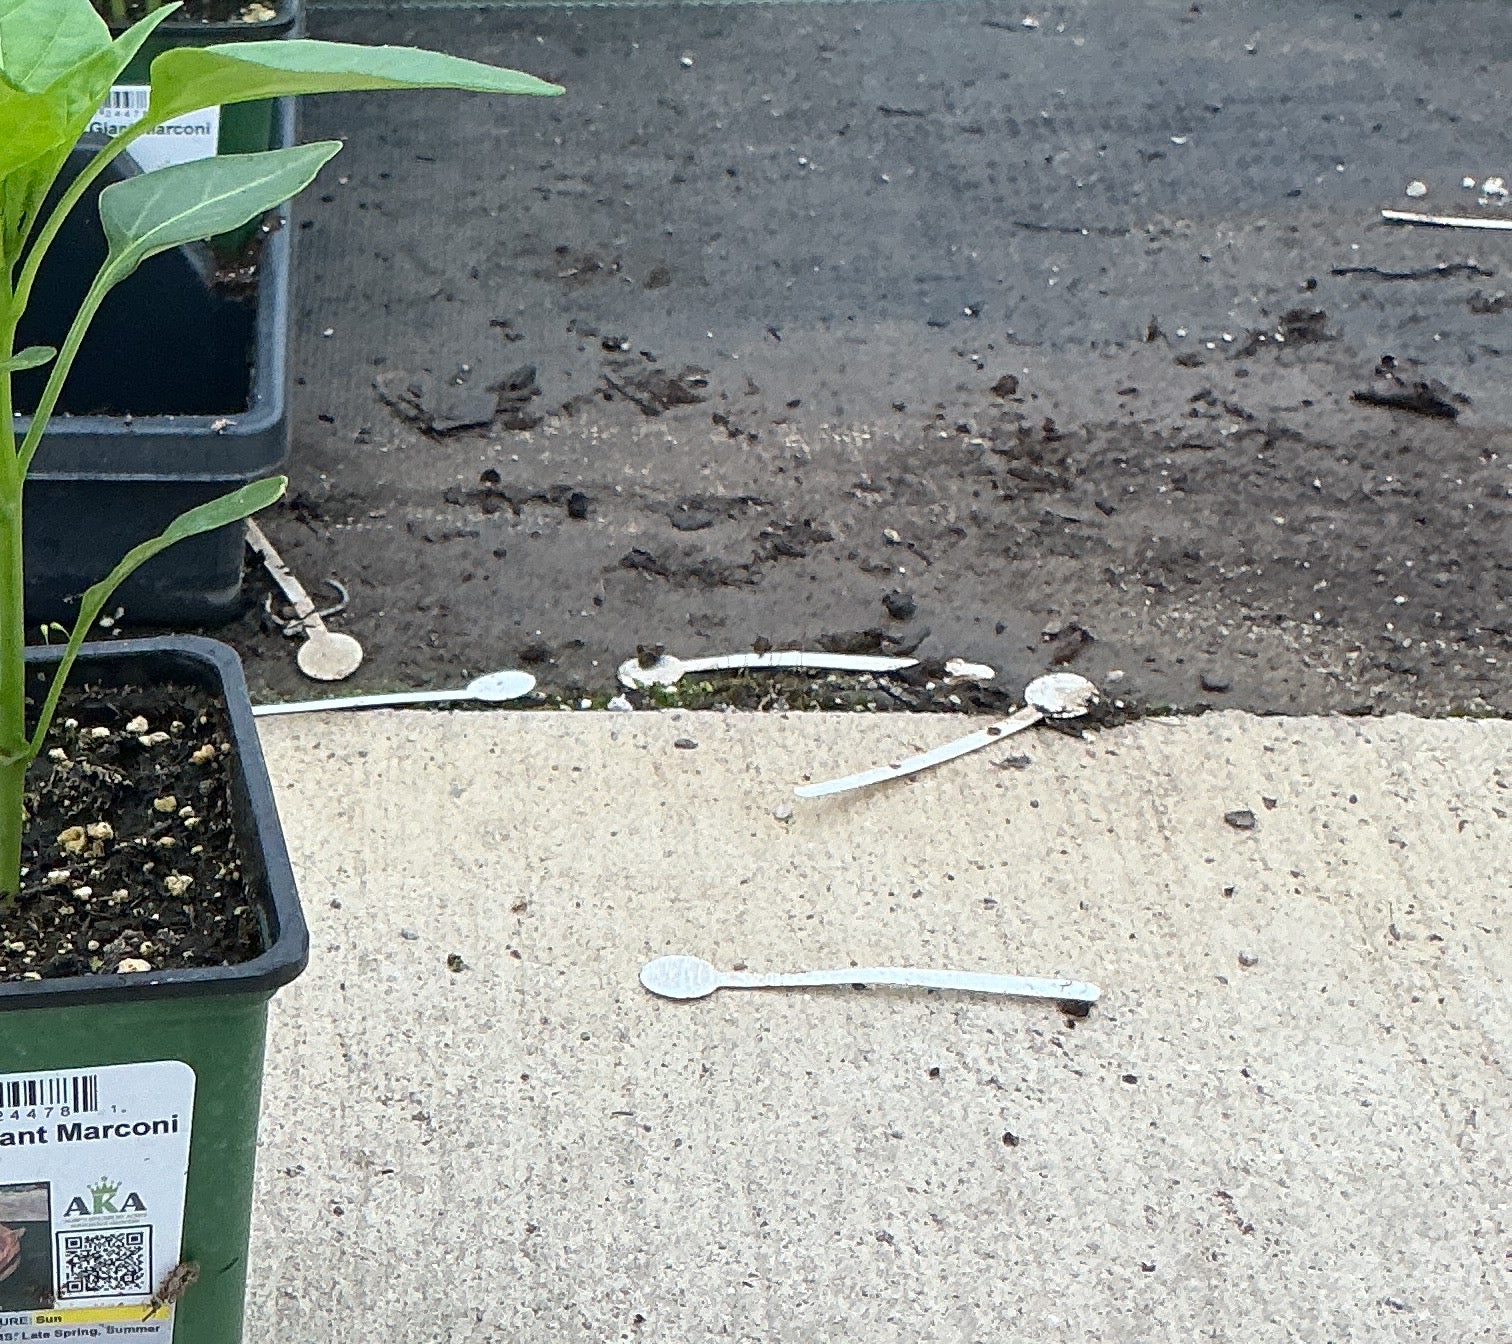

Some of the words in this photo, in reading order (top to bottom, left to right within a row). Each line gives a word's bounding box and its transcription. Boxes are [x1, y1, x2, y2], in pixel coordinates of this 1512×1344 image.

[57, 1114, 179, 1143] Marconi
[63, 1183, 148, 1217] AKA
[36, 1315, 62, 1324] Sun
[21, 1328, 50, 1340] Late
[105, 1324, 161, 1335] Summer
